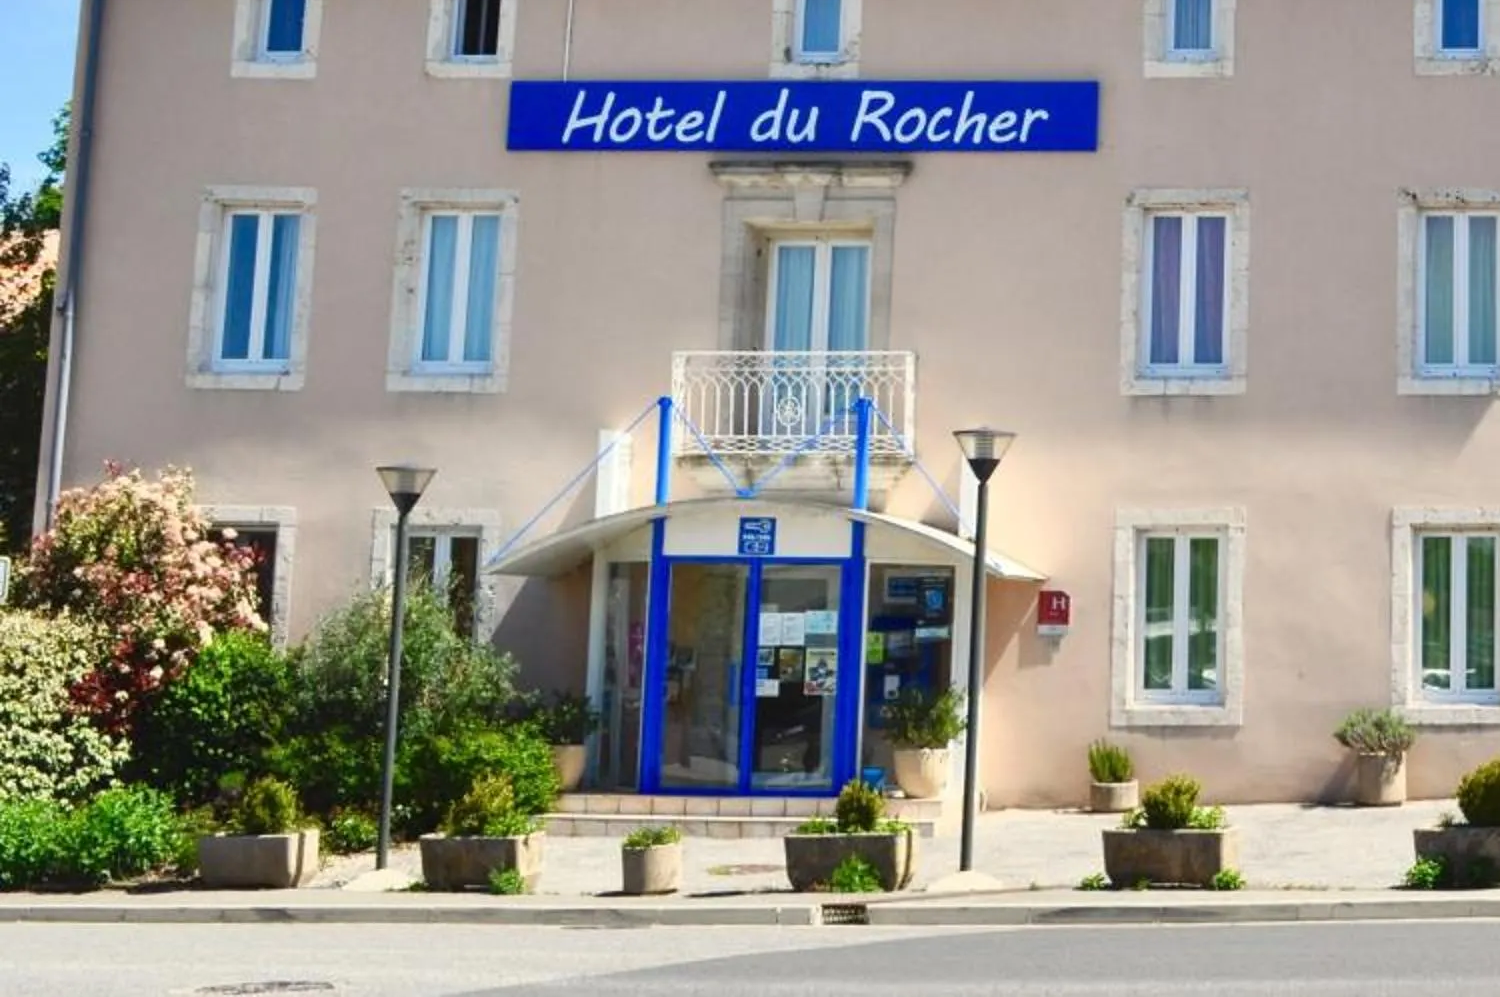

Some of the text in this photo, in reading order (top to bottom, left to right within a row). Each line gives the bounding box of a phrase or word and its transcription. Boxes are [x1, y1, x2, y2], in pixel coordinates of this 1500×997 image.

[562, 88, 1049, 144] Hotel du Rocher
[1051, 595, 1067, 611] H
